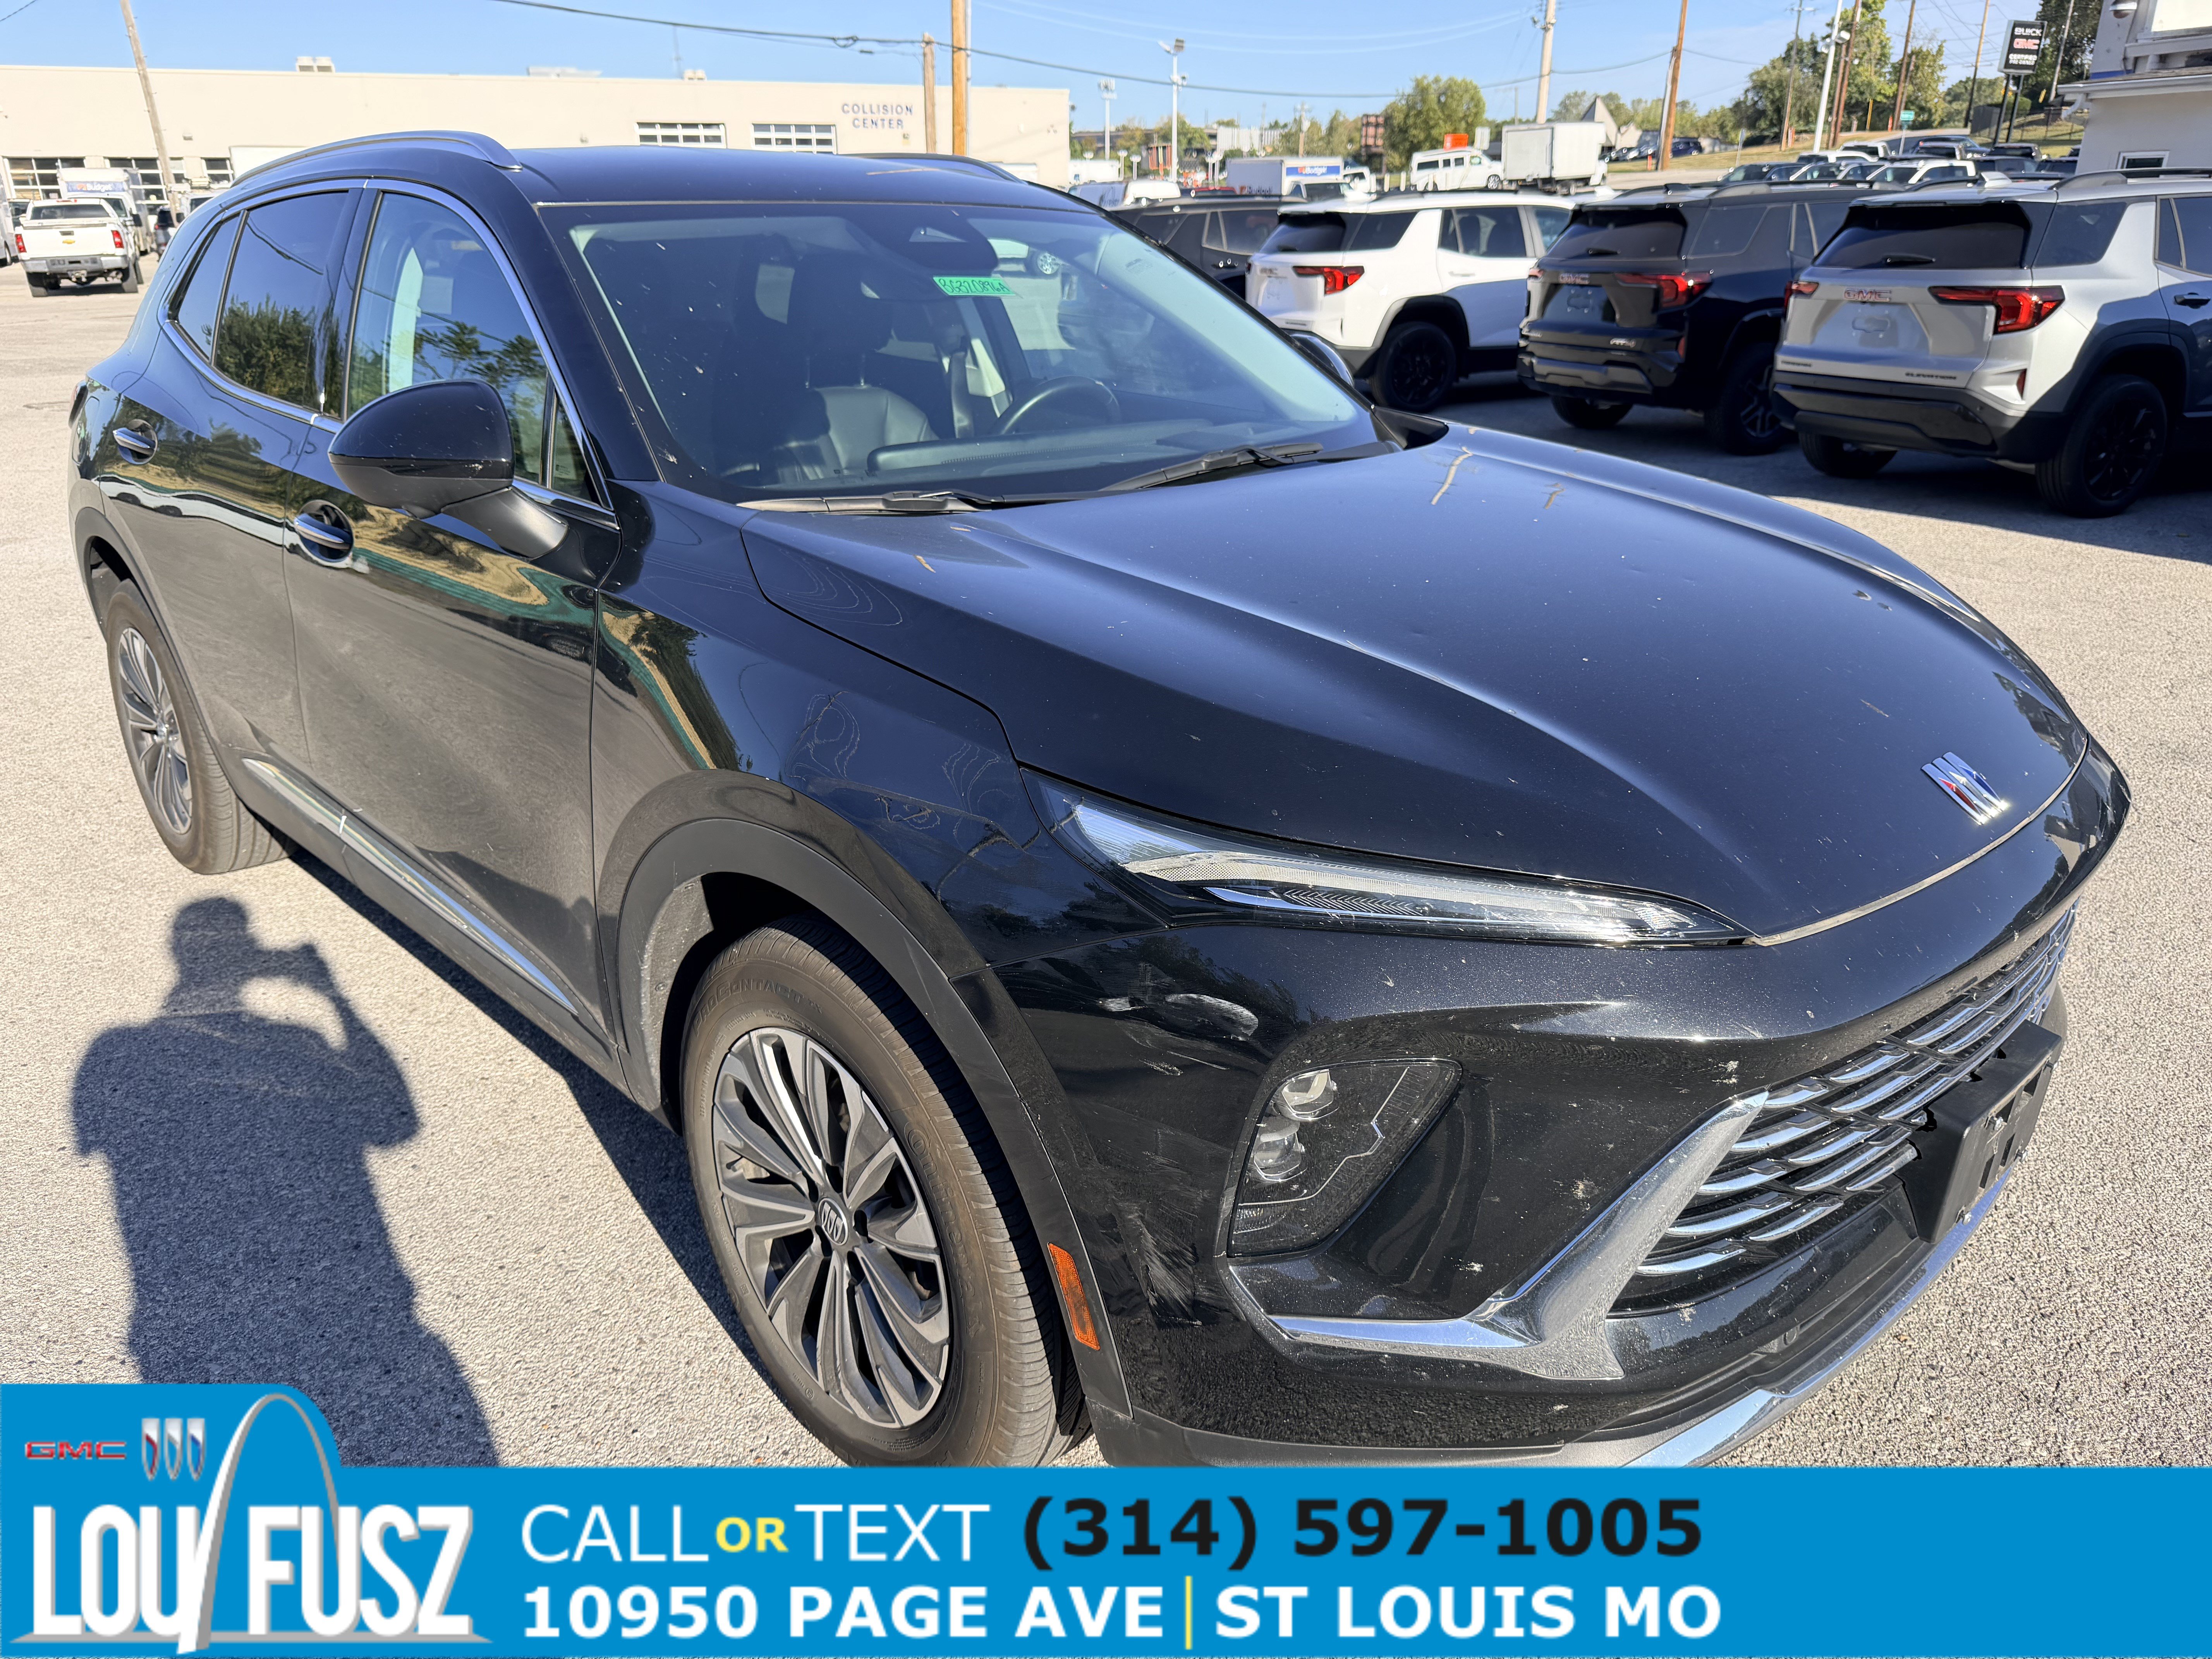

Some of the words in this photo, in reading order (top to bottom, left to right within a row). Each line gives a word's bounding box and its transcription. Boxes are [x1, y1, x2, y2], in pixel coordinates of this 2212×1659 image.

[2014, 27, 2042, 36] BUICK
[2013, 38, 2040, 50] GMC
[842, 103, 913, 115] COLLISION
[852, 118, 904, 129] CENTER
[1559, 273, 1590, 284] GMC
[1844, 288, 1892, 302] GMC
